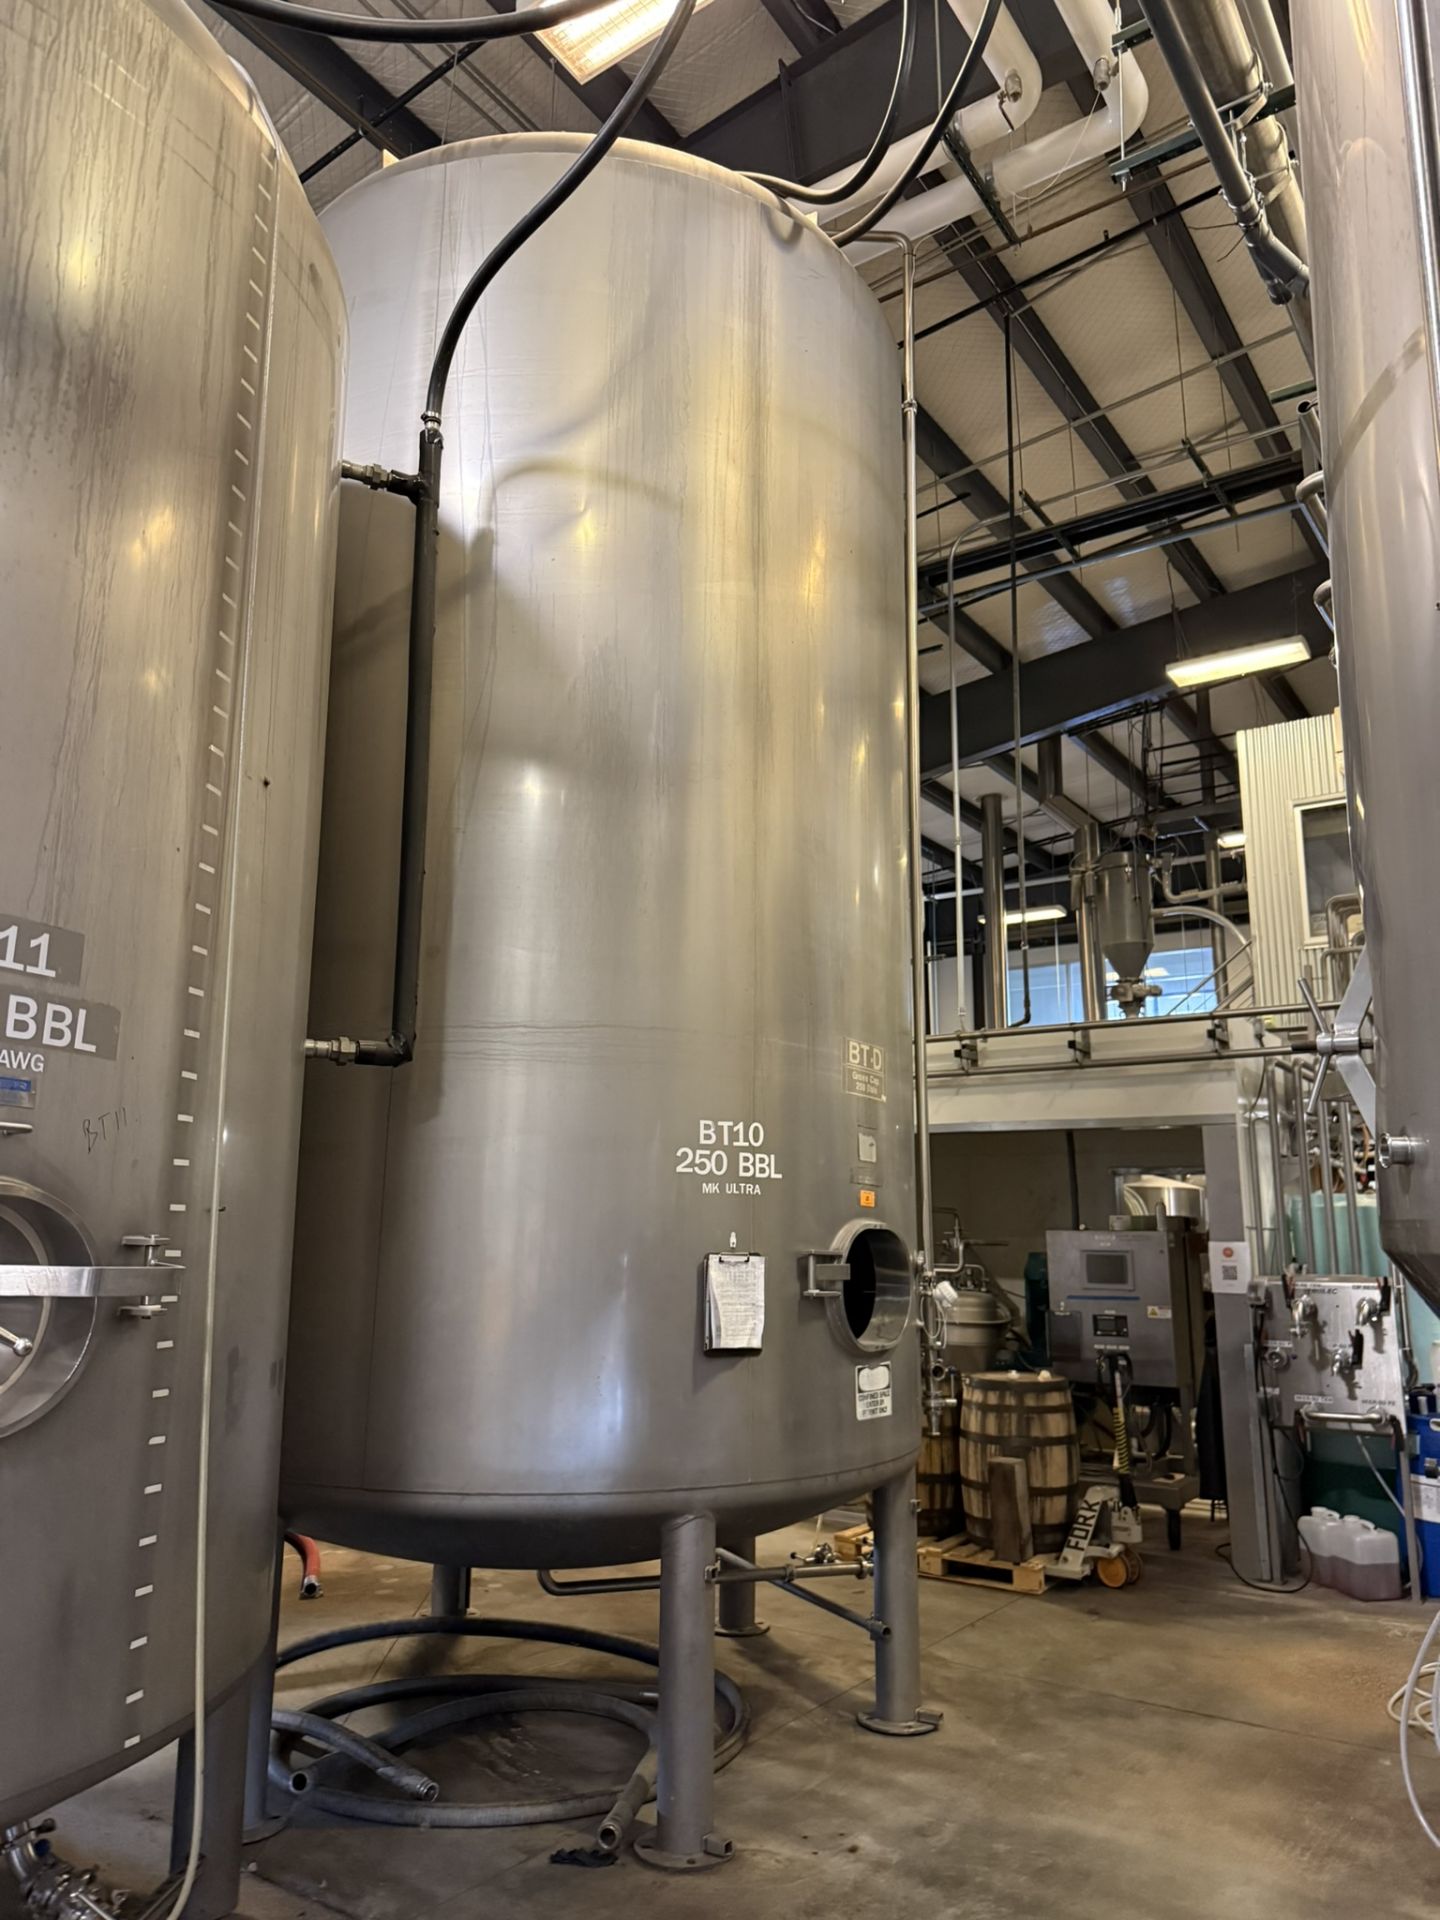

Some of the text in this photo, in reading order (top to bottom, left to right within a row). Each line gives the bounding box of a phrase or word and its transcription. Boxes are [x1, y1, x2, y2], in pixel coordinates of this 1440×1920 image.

[0, 925, 56, 978] 11
[5, 994, 97, 1053] BBL
[699, 1119, 764, 1147] BT10
[676, 1147, 783, 1179] 250 BBL
[702, 1182, 761, 1196] MK ULTRA
[1066, 1500, 1100, 1551] FORK
